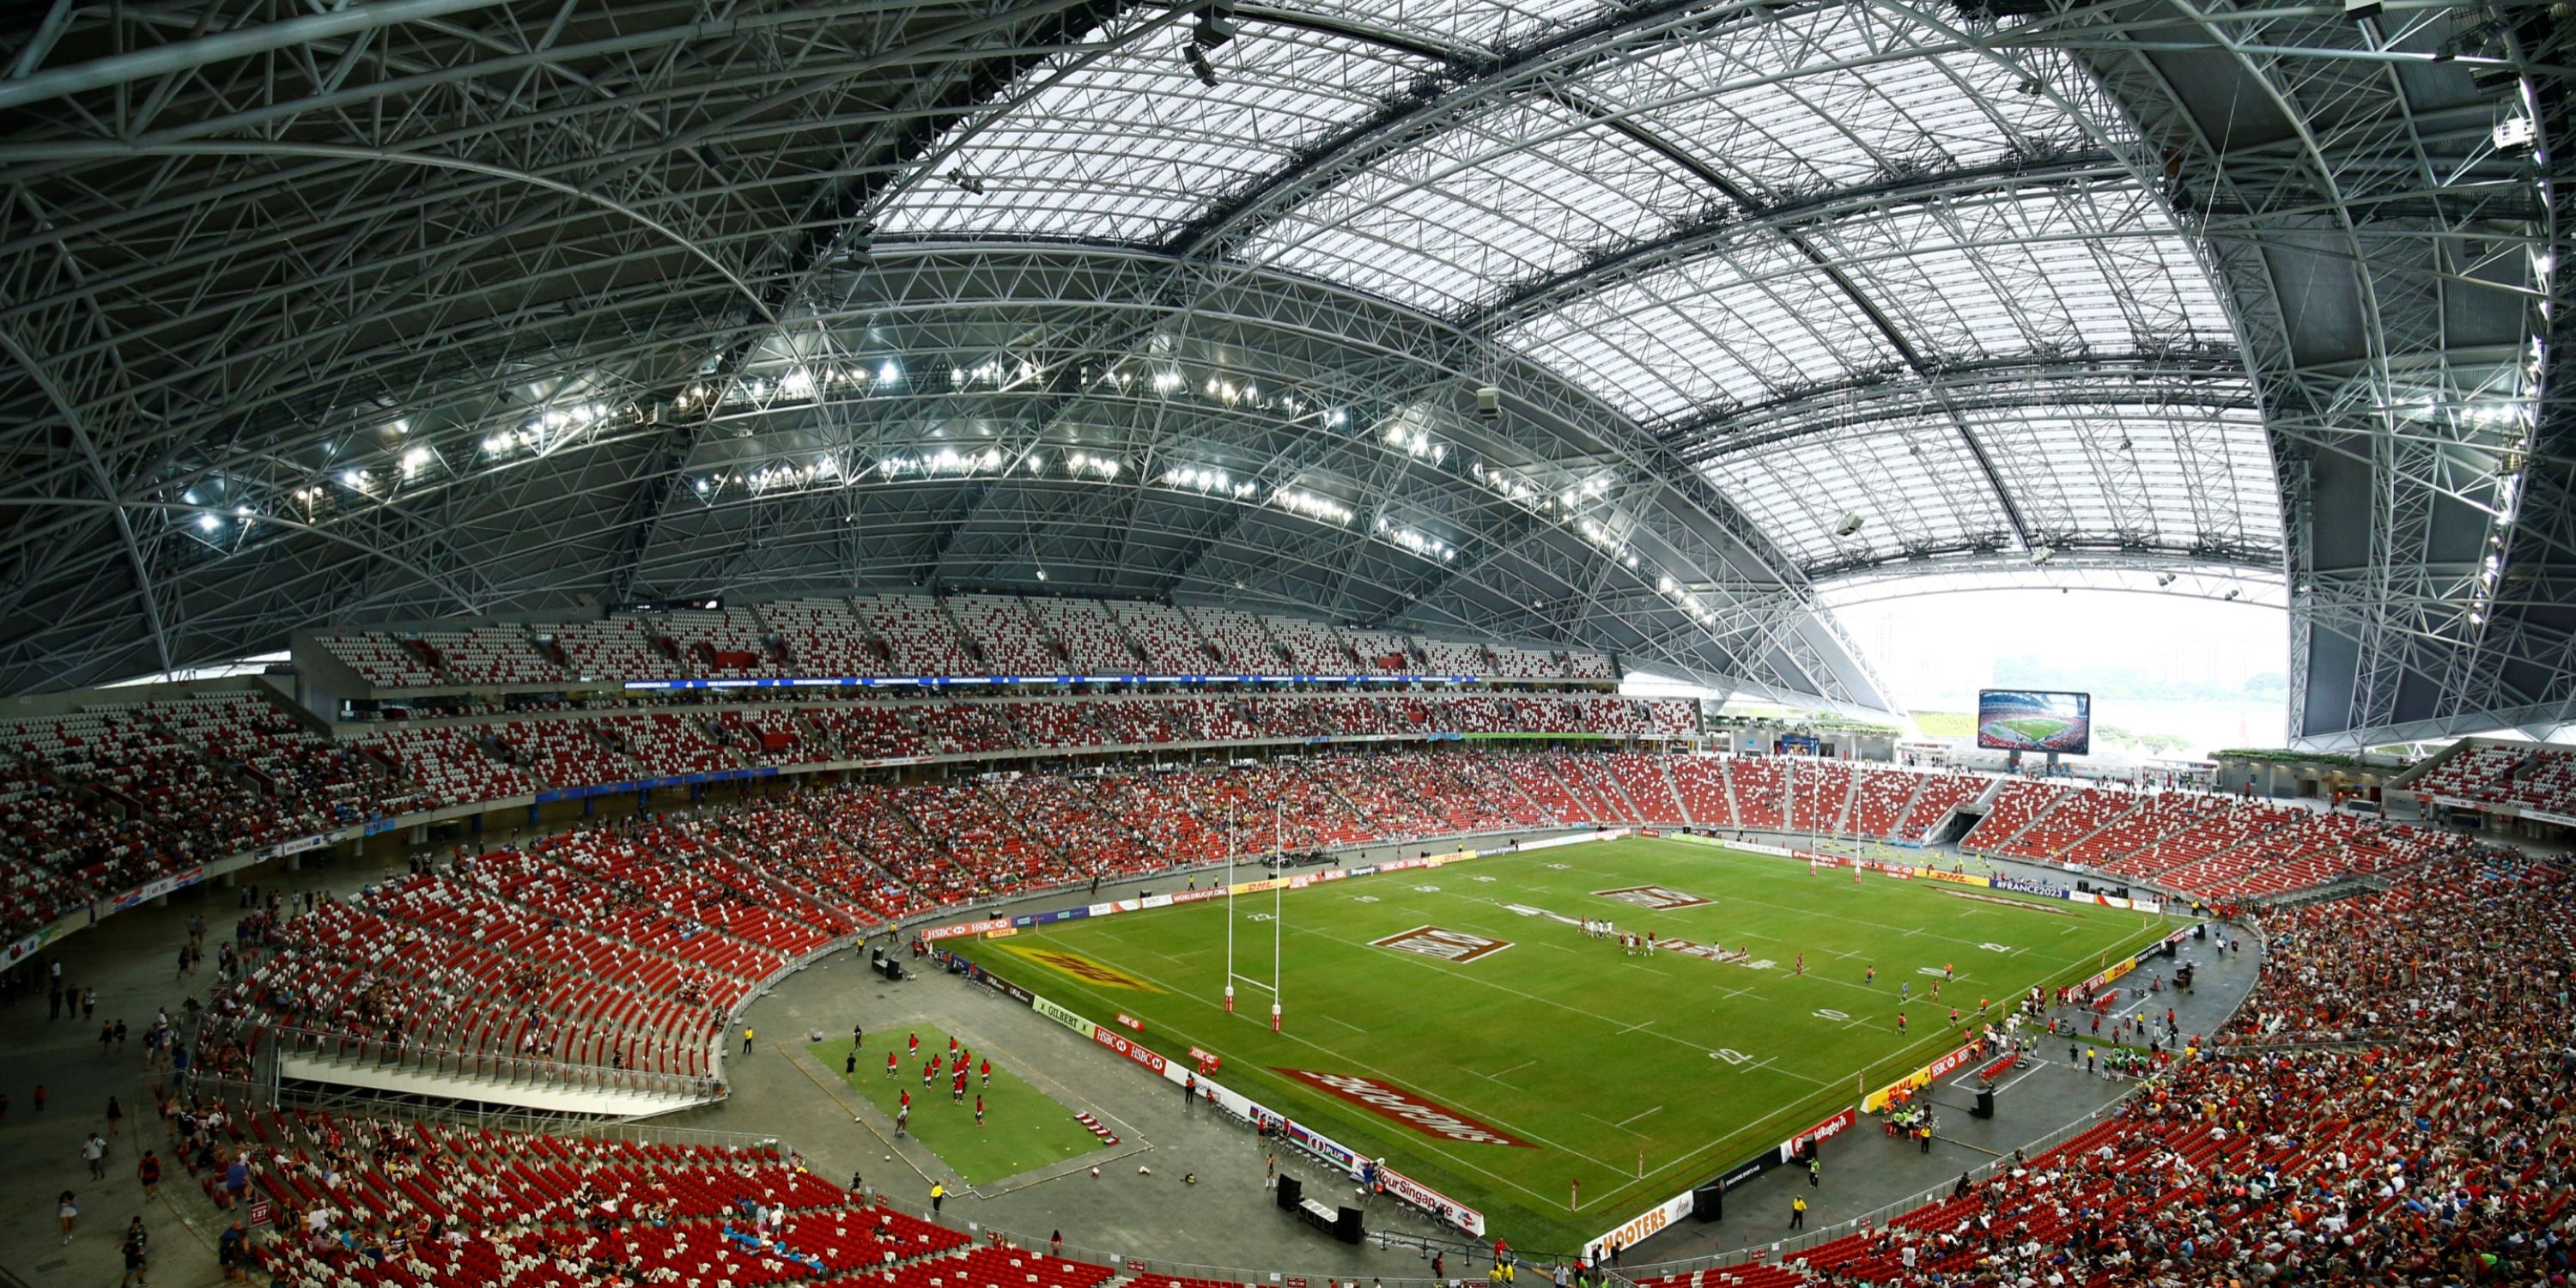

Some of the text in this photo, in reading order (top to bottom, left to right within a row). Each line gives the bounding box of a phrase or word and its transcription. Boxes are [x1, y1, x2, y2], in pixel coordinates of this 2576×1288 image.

[1883, 864, 1903, 873] HSBC
[1935, 872, 1966, 883] DHL
[1247, 882, 1273, 891] DHL
[1996, 881, 2063, 898] #FRANCE2023
[1174, 888, 1227, 902] WORLDRUGBY.ORG
[928, 927, 952, 939] HSBC
[971, 921, 995, 933] HSBC
[2113, 963, 2128, 977] DHL
[1048, 1005, 1078, 1029] GILBERT
[1097, 1029, 1152, 1066] HSBC HSBC
[1709, 1048, 1754, 1065] 22
[1932, 1060, 1948, 1078] HSBC
[1379, 1170, 1454, 1217] YourSingapre
[252, 1208, 267, 1219] 127
[1603, 1207, 1667, 1258] HOOTERS
